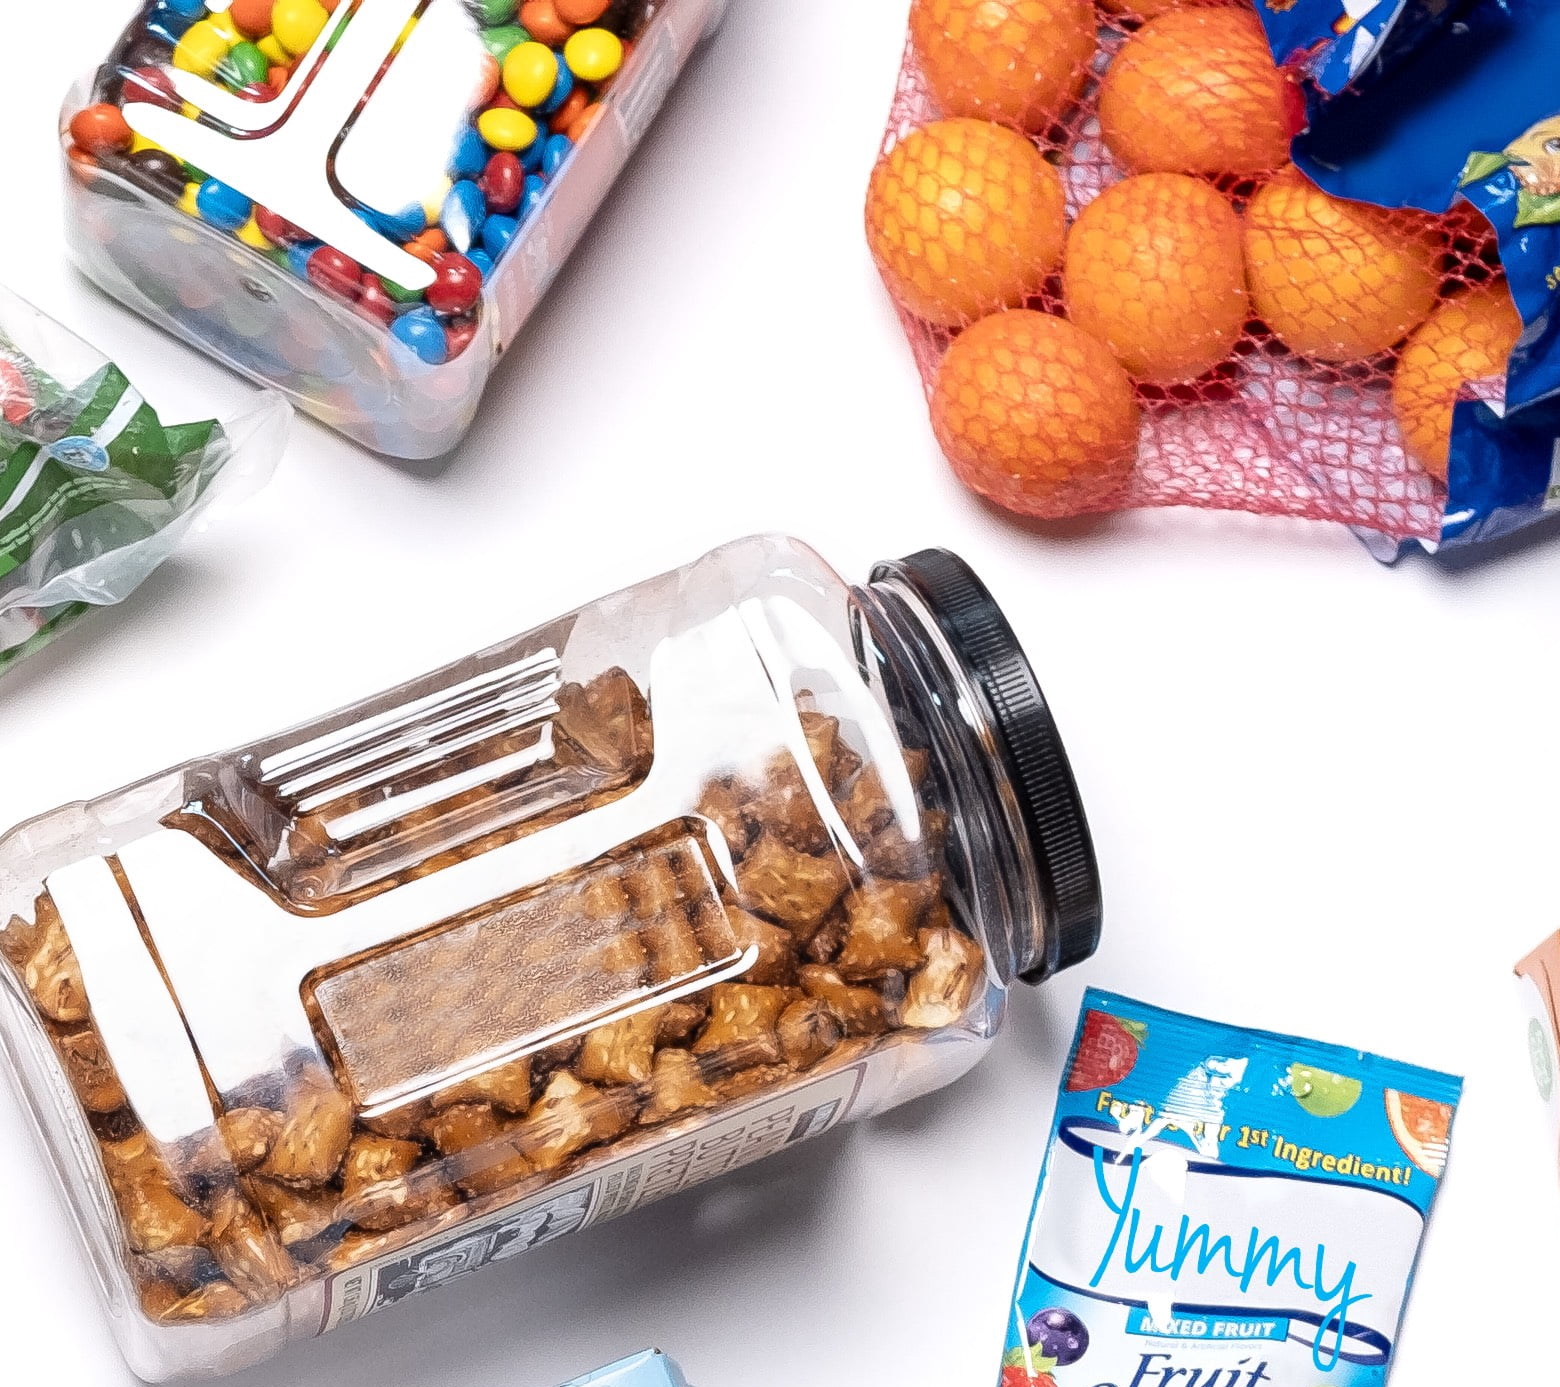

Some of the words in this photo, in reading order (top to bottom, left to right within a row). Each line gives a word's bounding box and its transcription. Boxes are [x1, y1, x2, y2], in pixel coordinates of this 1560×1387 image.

[1274, 1134, 1411, 1186] Ingredient!
[1089, 1145, 1373, 1372] Yummy
[1212, 1320, 1277, 1337] FRUIT
